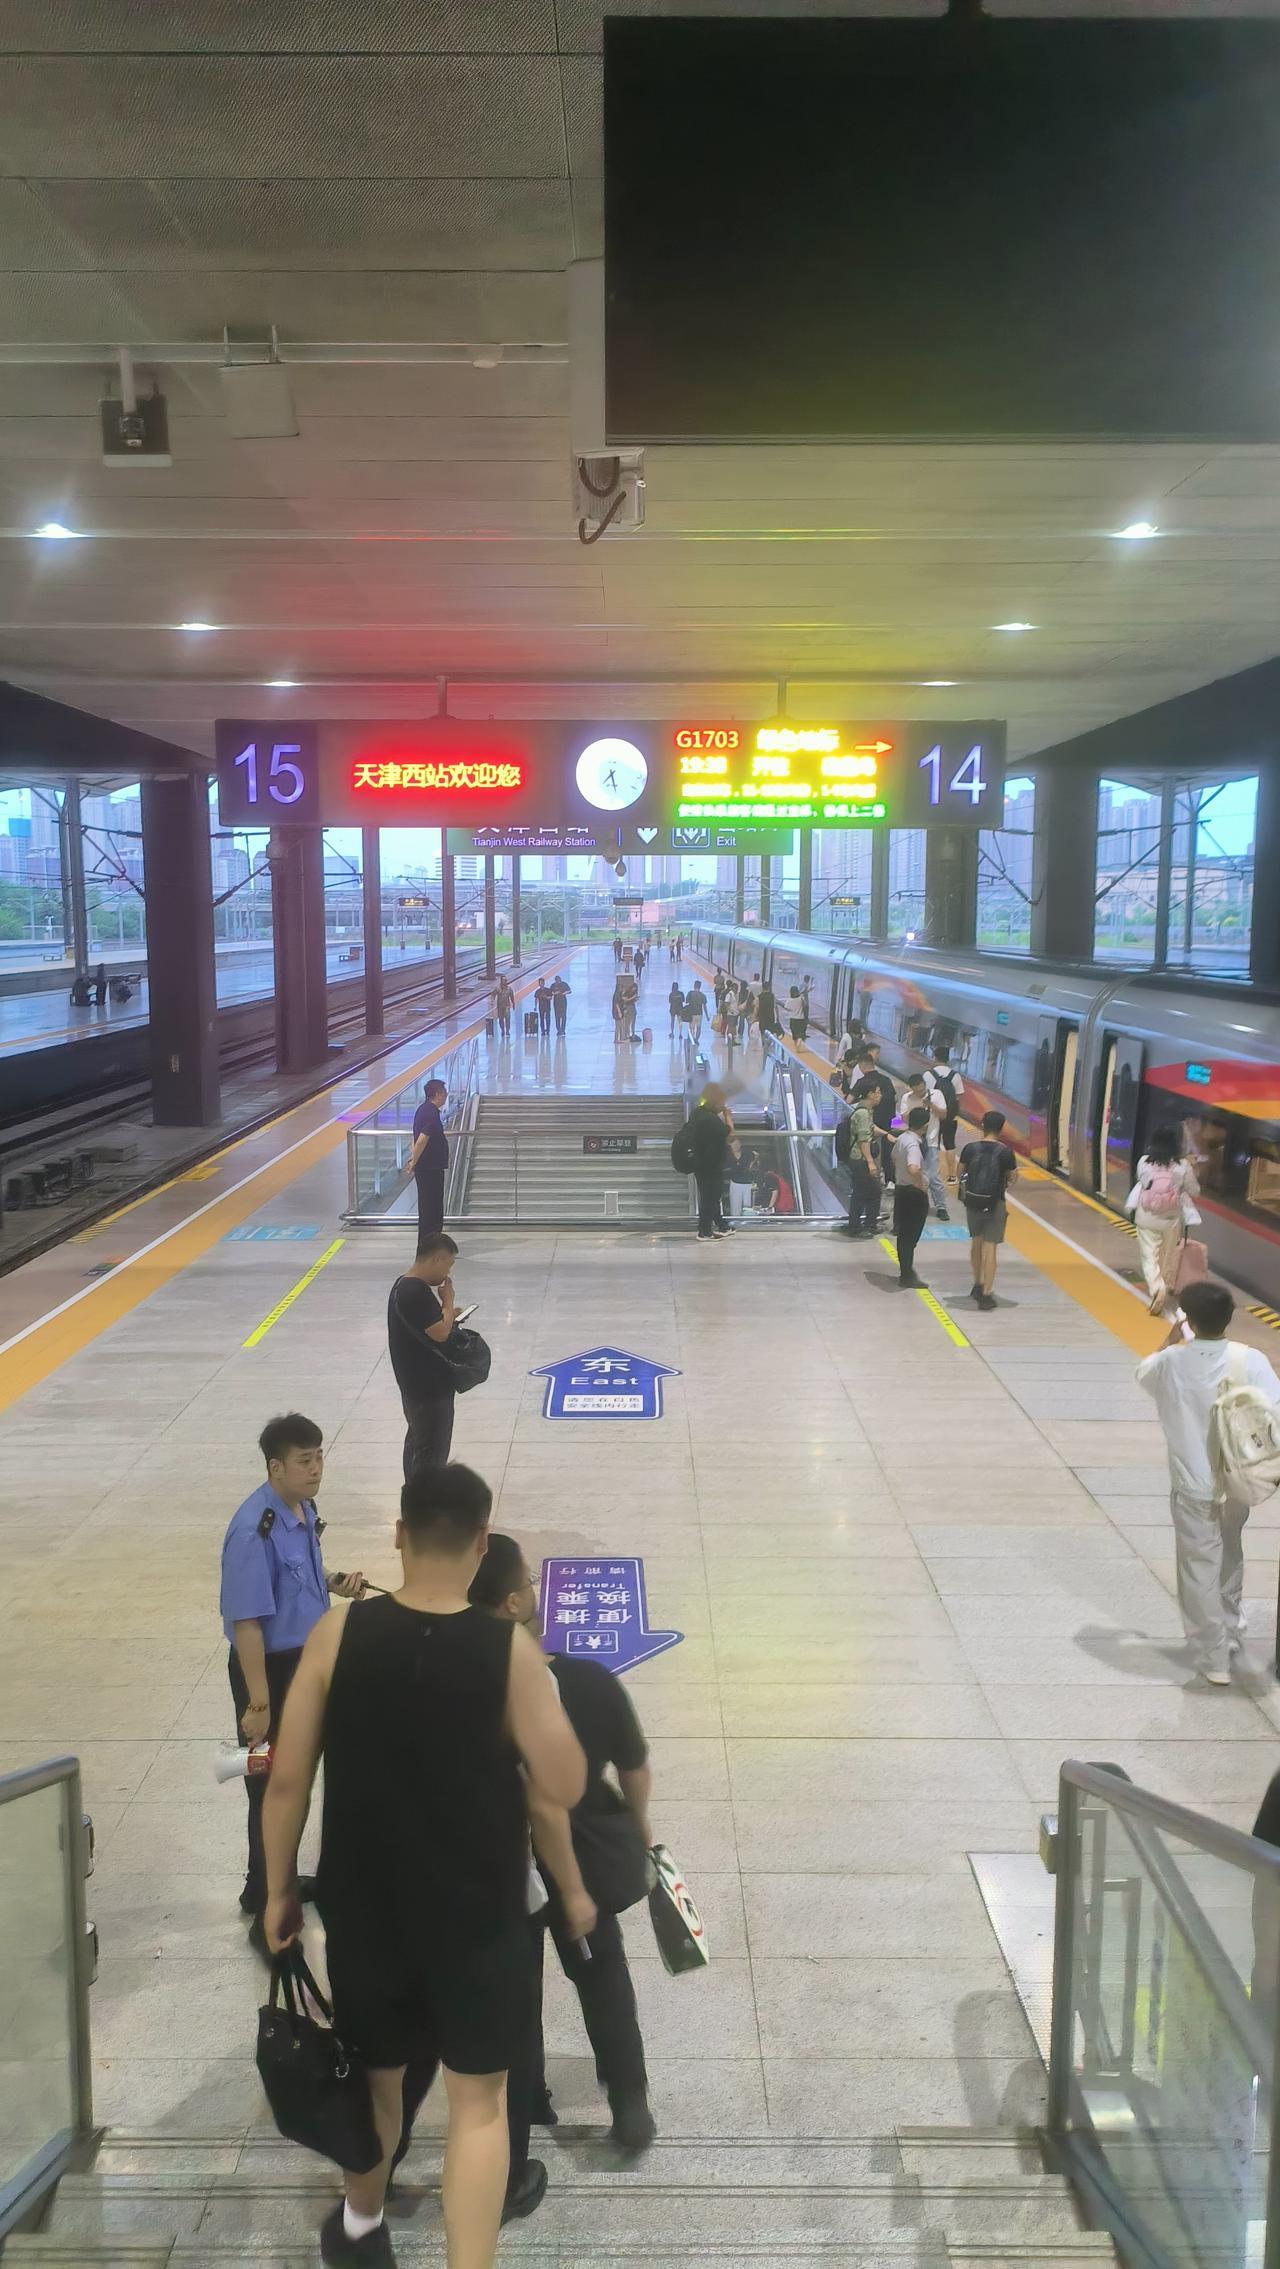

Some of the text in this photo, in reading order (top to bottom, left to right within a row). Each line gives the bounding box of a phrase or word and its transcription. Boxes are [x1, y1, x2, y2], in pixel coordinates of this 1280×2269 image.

[676, 730, 740, 748] G1703
[235, 743, 305, 804] 15
[353, 762, 521, 789] 天津西站欢迎您
[919, 744, 988, 805] 14
[472, 837, 596, 848] Tianjin West Railway Station
[716, 836, 736, 846] Exit
[581, 1357, 631, 1373] 东
[571, 1377, 639, 1385] East
[556, 1591, 631, 1605] 换乘
[554, 1609, 633, 1624] 便捷
